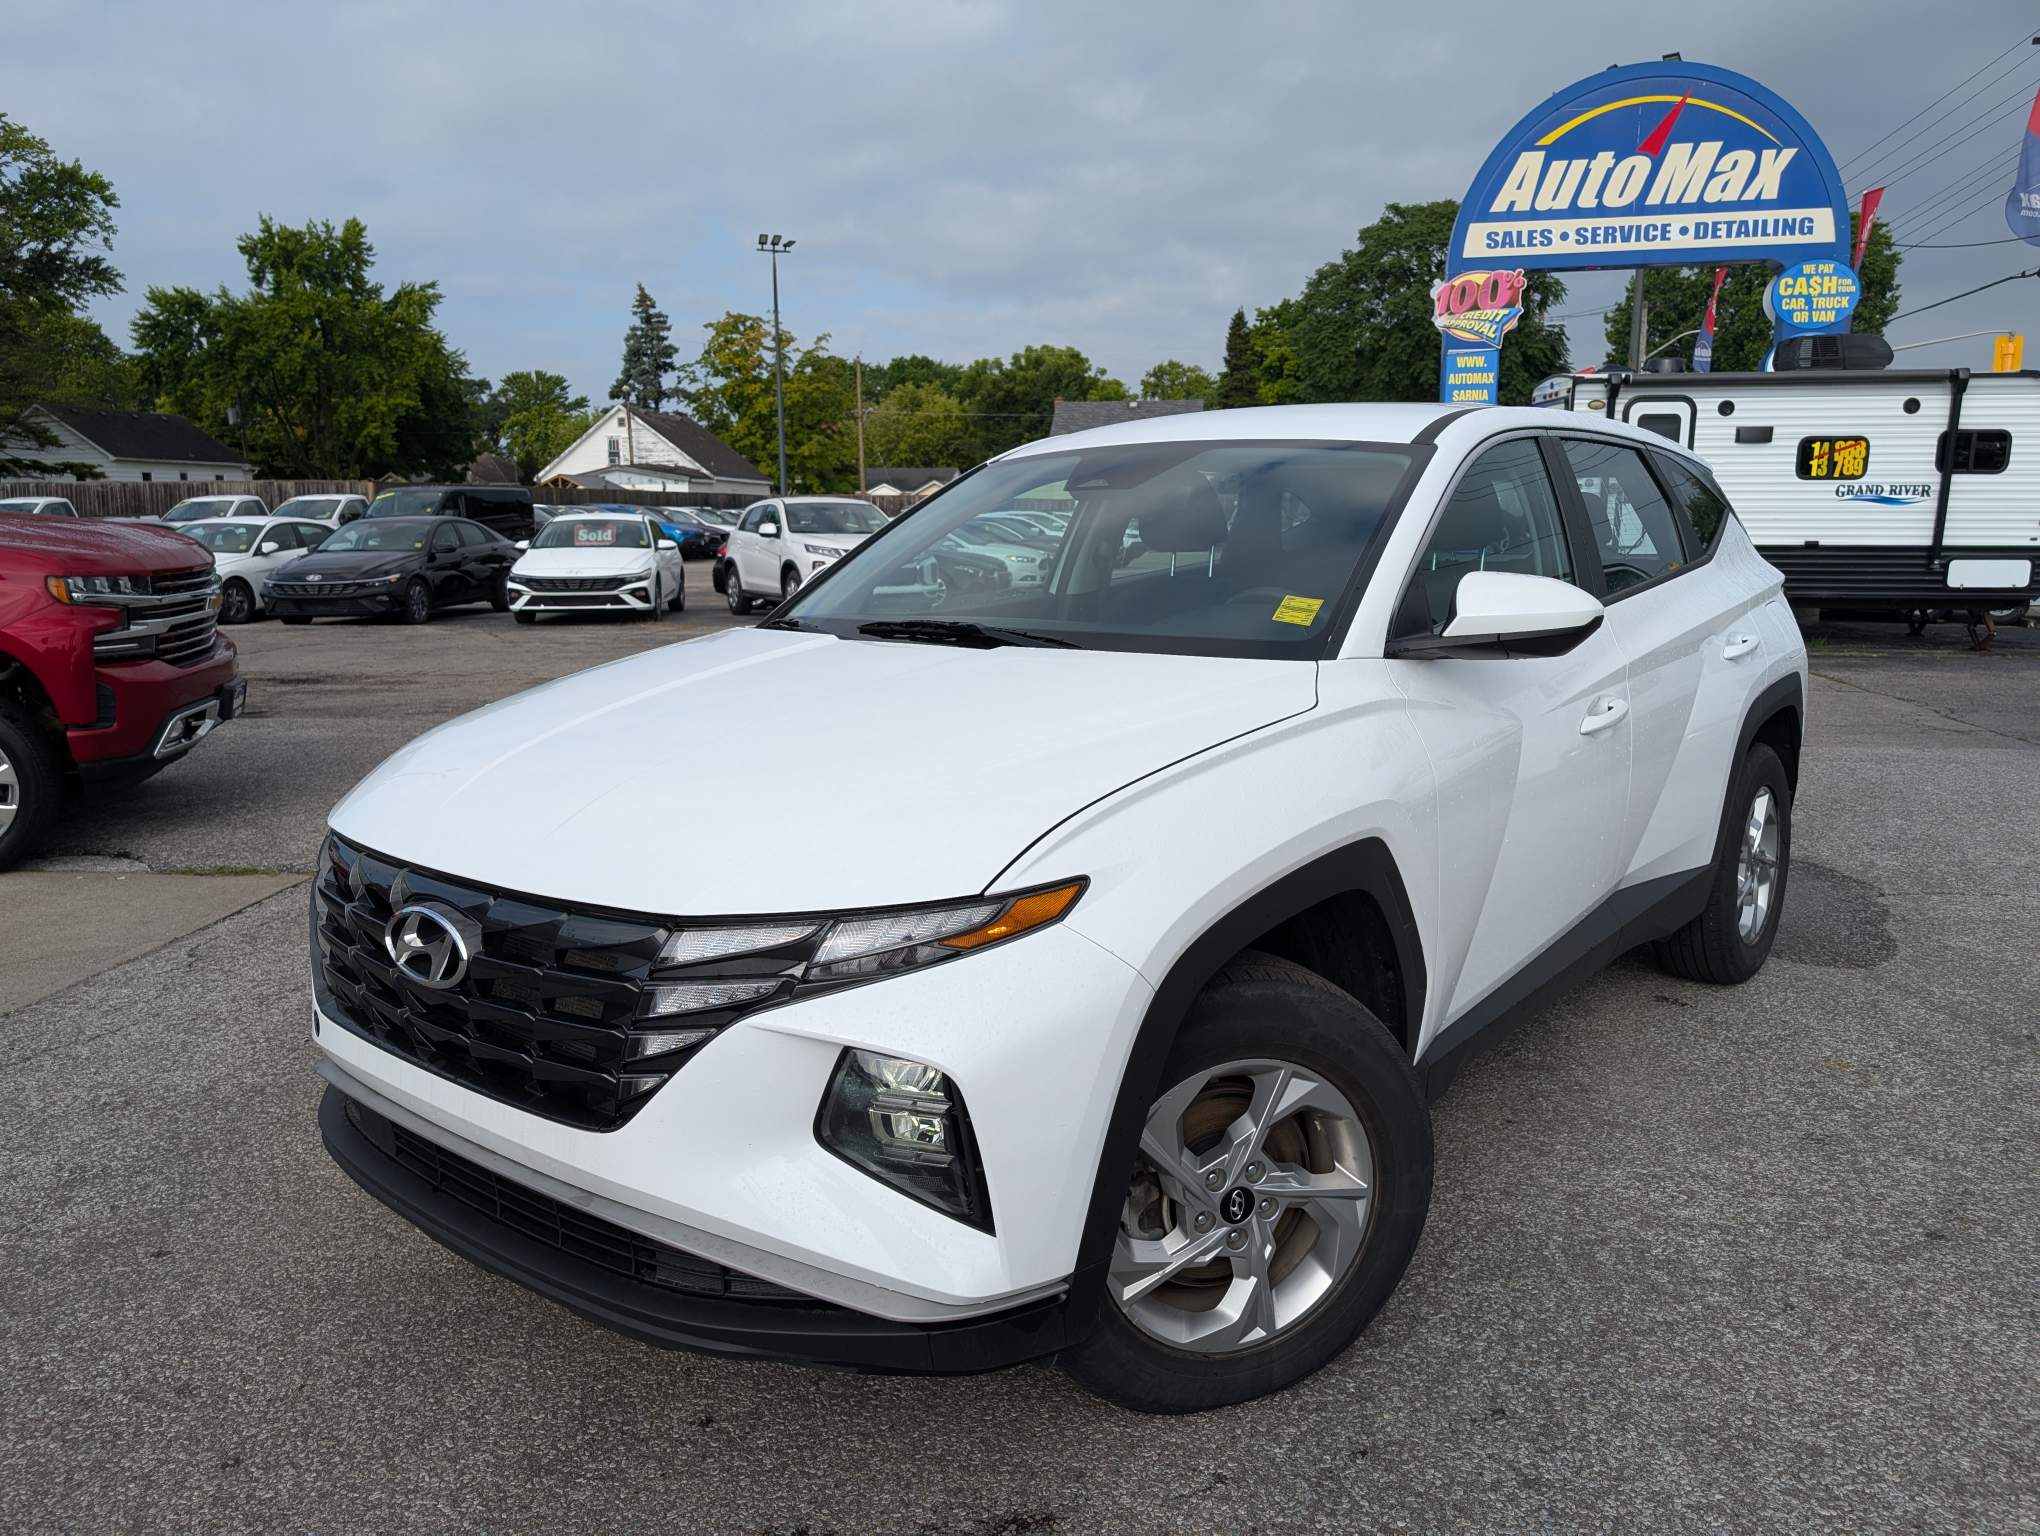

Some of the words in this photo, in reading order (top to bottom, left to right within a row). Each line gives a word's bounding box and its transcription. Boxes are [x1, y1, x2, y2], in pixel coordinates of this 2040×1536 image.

[1489, 141, 1799, 212] AutoMax
[1486, 228, 1553, 249] SALES
[1575, 223, 1671, 245] SERVICE
[1694, 217, 1815, 240] DETAILING
[1803, 264, 1816, 274] WE
[1818, 264, 1834, 274] PAY
[1779, 275, 1837, 296] CA$H
[1436, 270, 1525, 315] 100%
[1782, 298, 1808, 310] CAR,
[1812, 296, 1849, 309] TRUCK
[1460, 309, 1510, 322] CREDIT
[1793, 311, 1809, 323] OR
[1812, 310, 1836, 322] VAN
[1448, 373, 1495, 384] AUTOMAX
[1452, 390, 1489, 401] SARNIA
[1835, 485, 1884, 497] GRAND
[1889, 485, 1931, 497] RIVER
[578, 529, 612, 541] Sold
